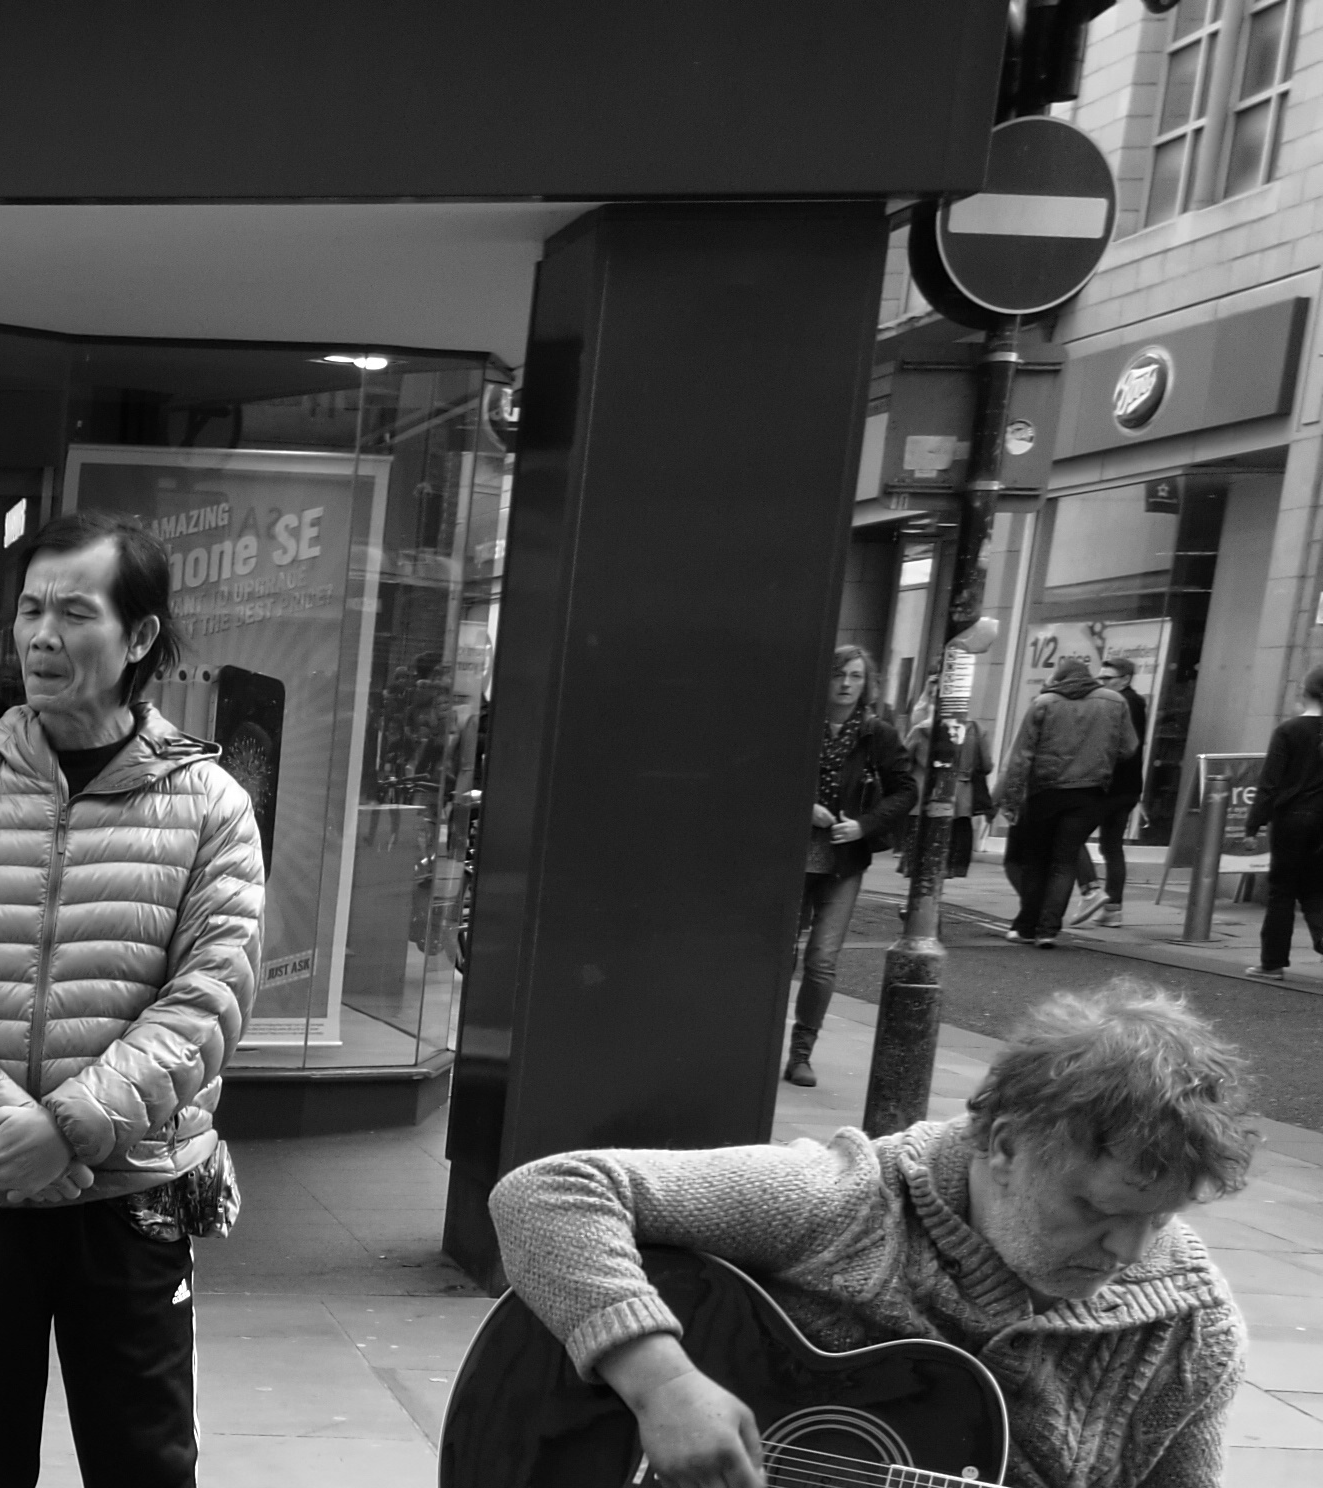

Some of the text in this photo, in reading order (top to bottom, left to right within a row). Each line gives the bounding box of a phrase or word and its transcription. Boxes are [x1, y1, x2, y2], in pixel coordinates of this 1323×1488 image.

[151, 503, 230, 541] AMAZING
[168, 506, 324, 592] hone SE
[1030, 636, 1058, 669] 1/2
[267, 958, 310, 980] JUST ASK
